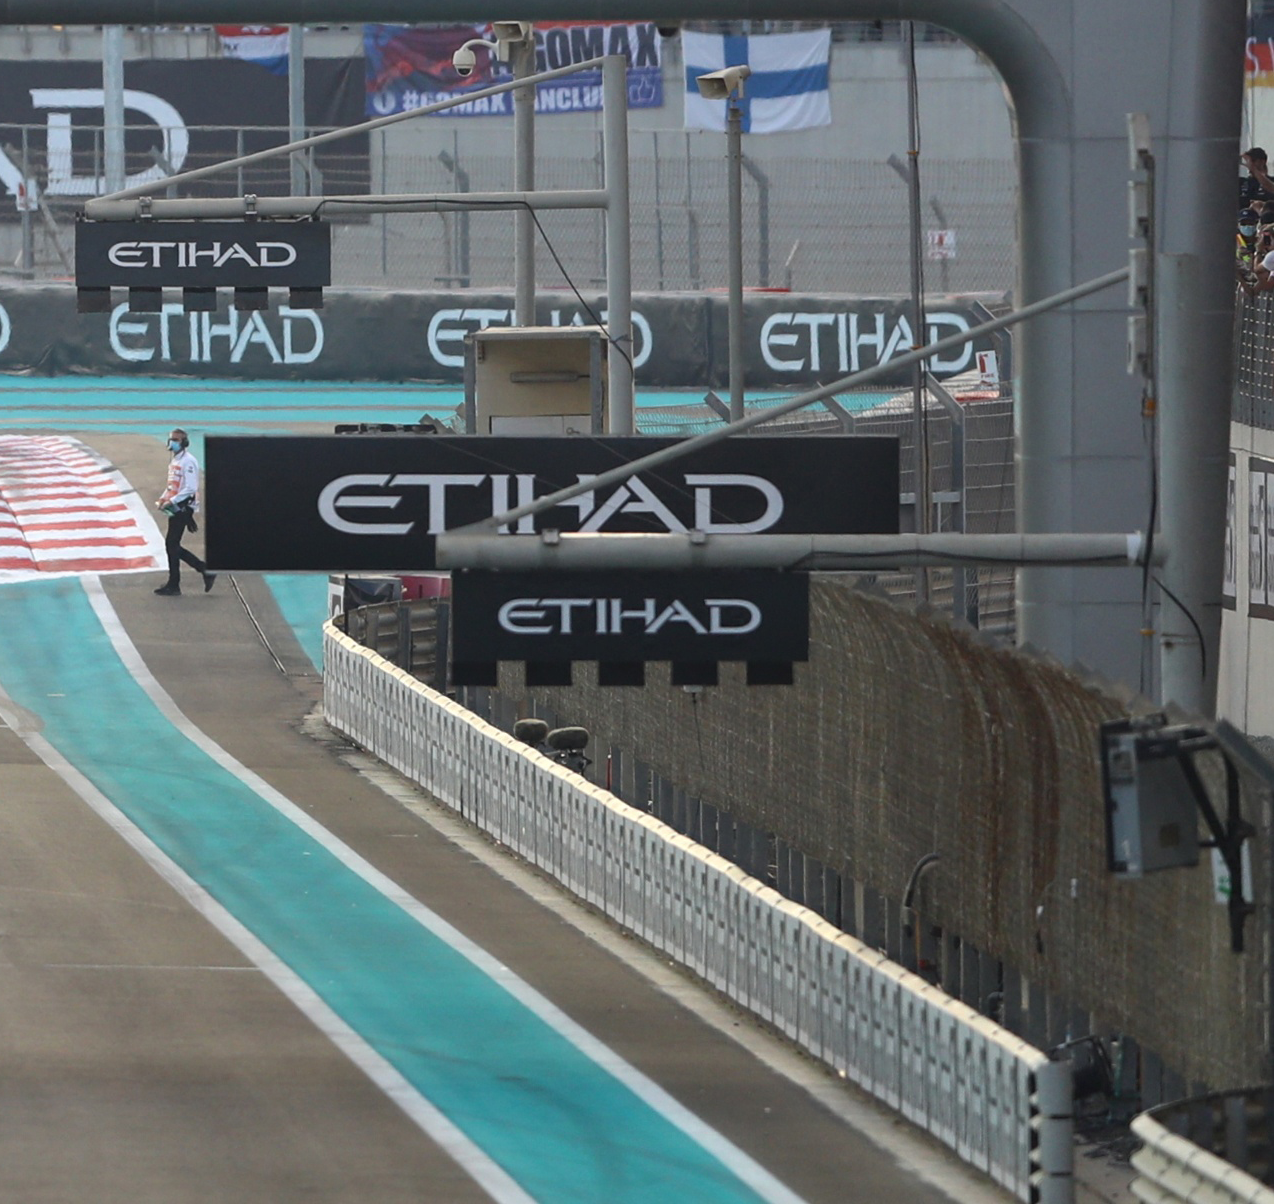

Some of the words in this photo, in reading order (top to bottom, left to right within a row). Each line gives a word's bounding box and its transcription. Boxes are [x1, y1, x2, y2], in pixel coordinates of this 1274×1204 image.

[109, 242, 296, 267] ETIHAD
[109, 302, 324, 364] ETIHAD
[760, 312, 973, 372] ETIHAD
[318, 474, 784, 534] ETIHAD
[498, 599, 761, 633] ETIHAD
